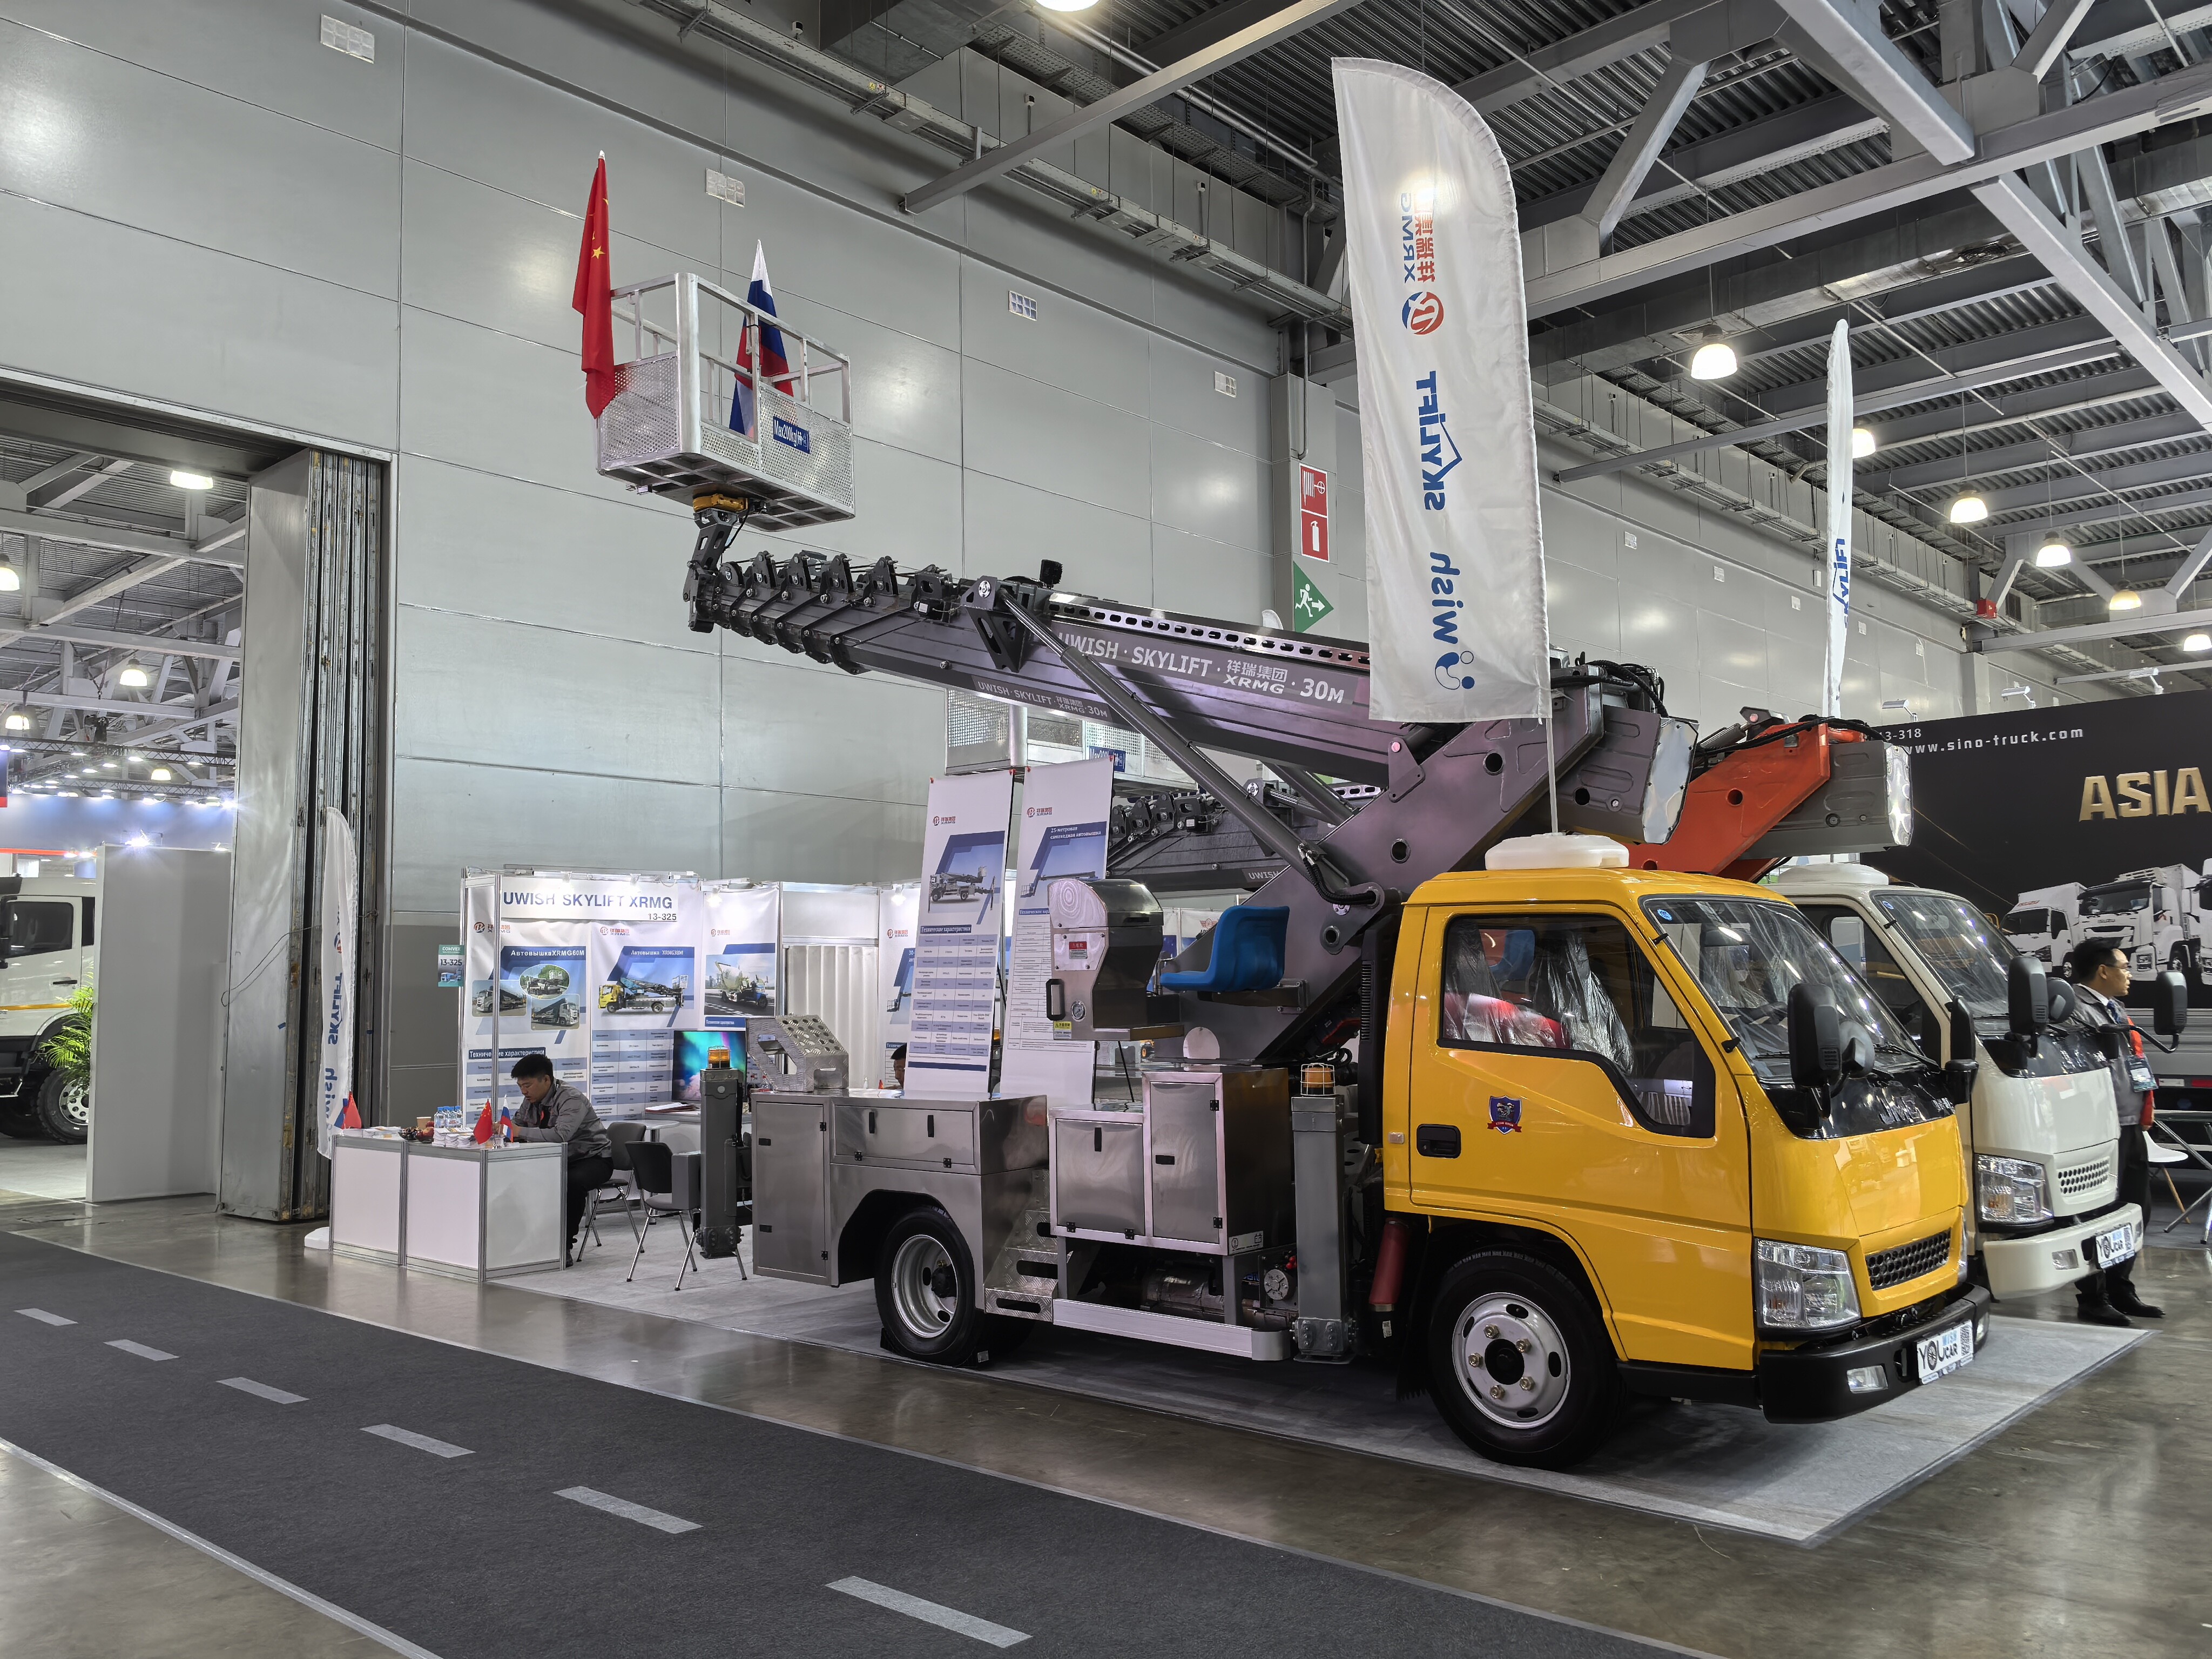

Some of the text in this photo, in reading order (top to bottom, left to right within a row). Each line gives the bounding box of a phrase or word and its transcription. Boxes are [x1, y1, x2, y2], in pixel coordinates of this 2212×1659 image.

[1132, 646, 1212, 677] SKYLIFT
[1227, 659, 1287, 683] 祥瑞集团
[977, 682, 1051, 705] UWISH SKYLIFT
[1223, 674, 1285, 694] XRMG
[1058, 703, 1085, 713] XRMG
[1880, 729, 1921, 741] 3-318
[1906, 727, 2083, 755] www.sino-truck.com
[2079, 767, 2212, 822] ASIA
[503, 892, 672, 909] UWISH SKYLIFT XRMG
